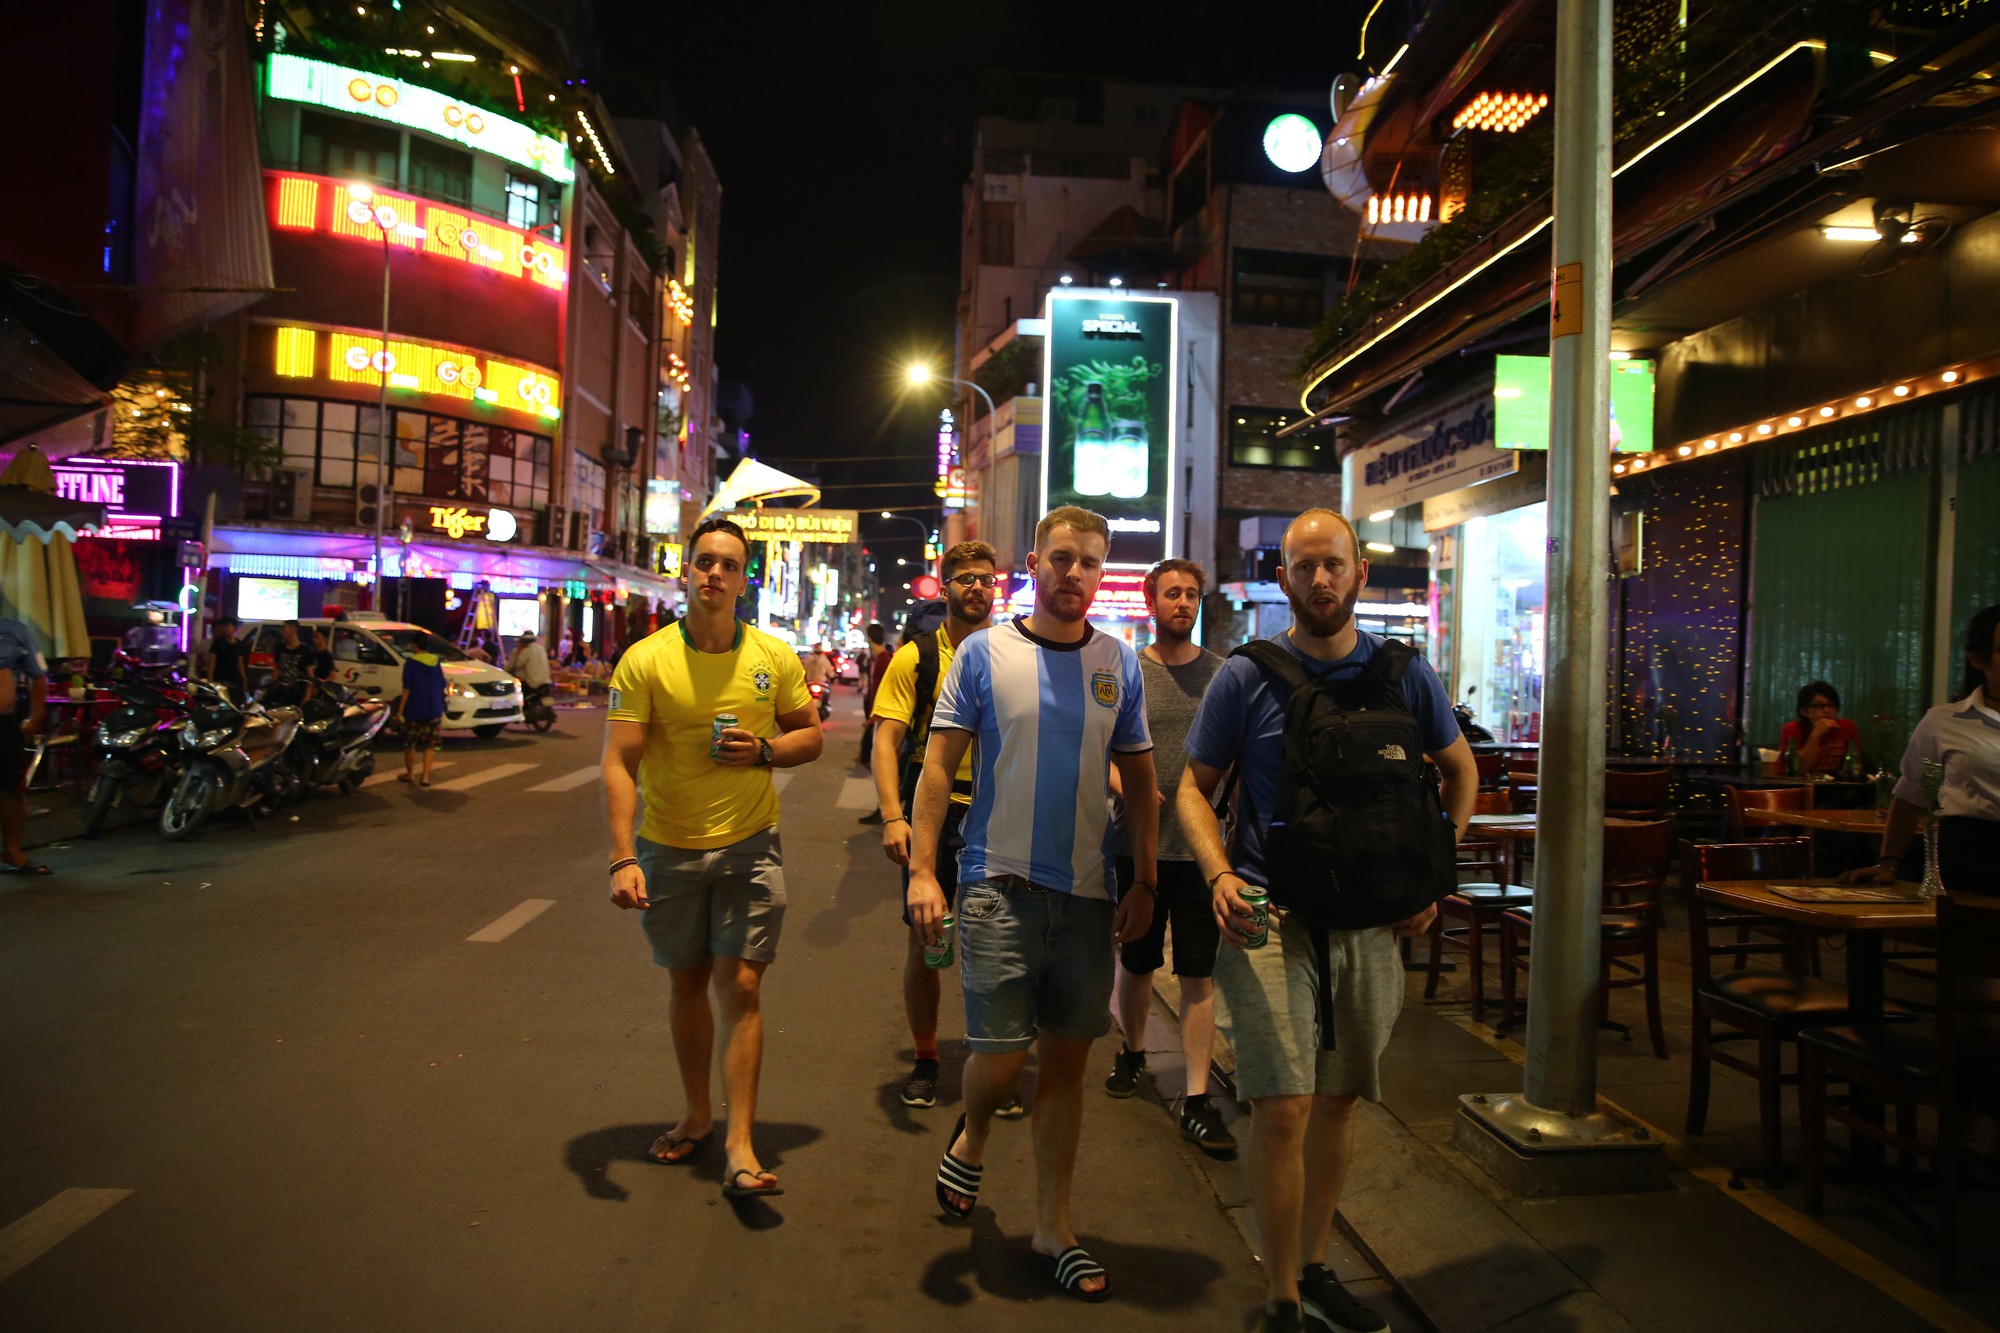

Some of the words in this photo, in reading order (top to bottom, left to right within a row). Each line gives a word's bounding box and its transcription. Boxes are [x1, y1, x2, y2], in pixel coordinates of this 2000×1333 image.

[1082, 319, 1141, 333] SPECIAL
[345, 346, 396, 373] GO
[436, 360, 482, 389] GO
[54, 472, 125, 504] FFLINE
[429, 507, 486, 539] Tiger
